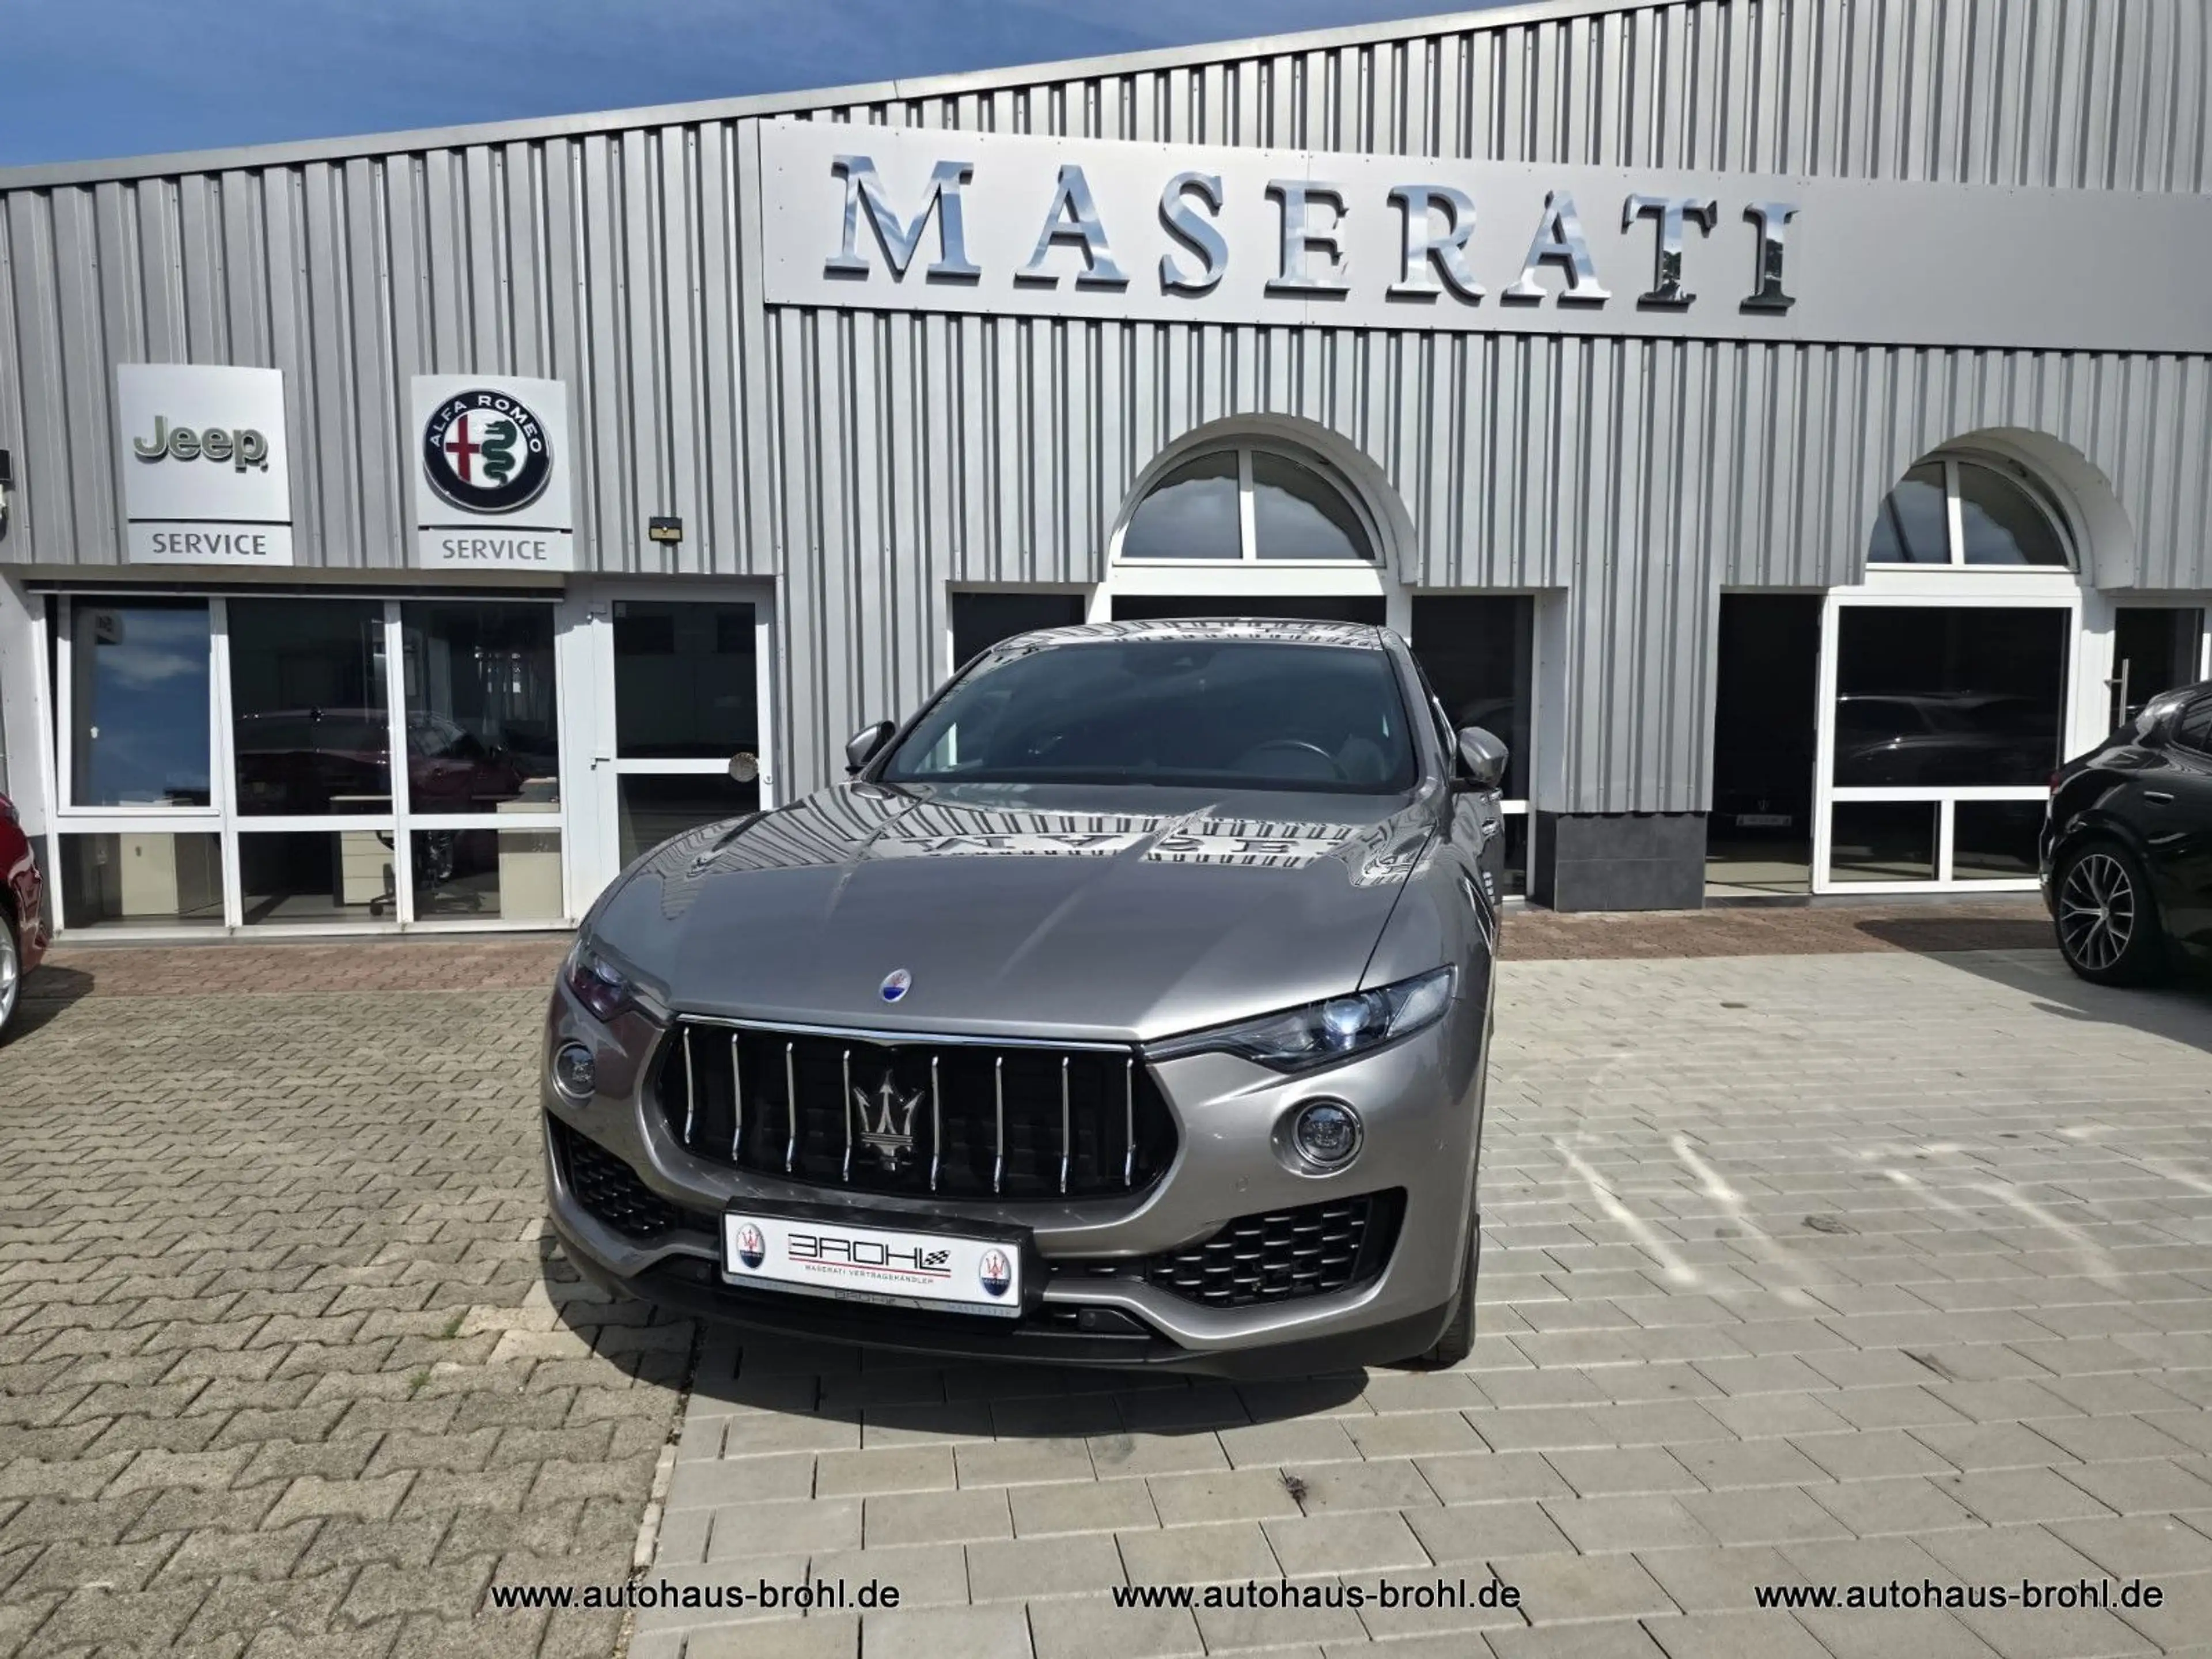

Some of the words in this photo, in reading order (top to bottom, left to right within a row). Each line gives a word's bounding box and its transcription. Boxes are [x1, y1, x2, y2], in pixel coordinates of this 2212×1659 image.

[823, 154, 1801, 317] MASERATI
[133, 414, 268, 474] Jeep
[429, 400, 468, 448] ALFA
[478, 395, 543, 453] ROMEO
[151, 533, 267, 555] SERVICE
[442, 539, 547, 560] SERVICE
